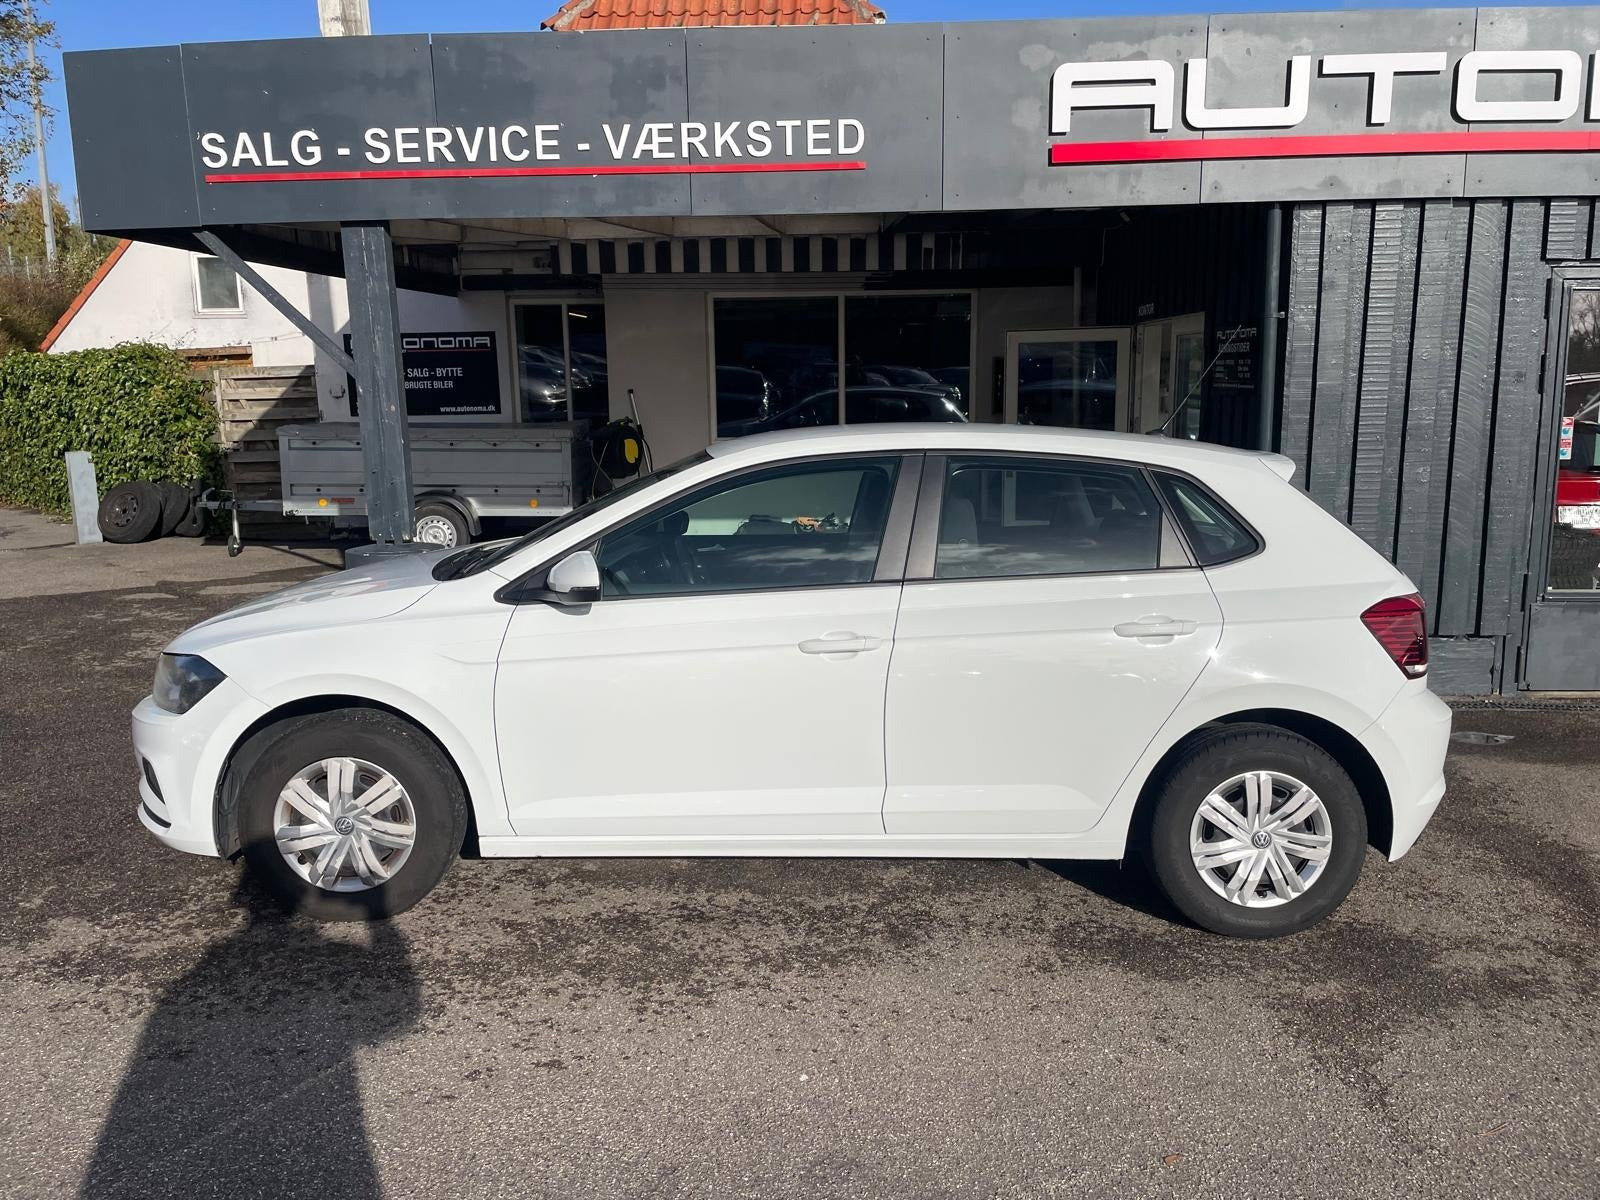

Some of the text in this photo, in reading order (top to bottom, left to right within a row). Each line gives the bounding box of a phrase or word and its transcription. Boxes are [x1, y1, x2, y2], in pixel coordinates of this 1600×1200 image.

[1051, 50, 1600, 133] AUTO
[201, 130, 322, 168] SALG
[364, 124, 560, 164] SERVICE
[602, 119, 865, 160] VÆRKSTED
[403, 336, 491, 349] ONOMA
[407, 367, 429, 377] SALG
[436, 367, 463, 377] BYTTE
[404, 380, 454, 389] BRUGTE BILER
[439, 404, 496, 413] www.autonoma.dk
